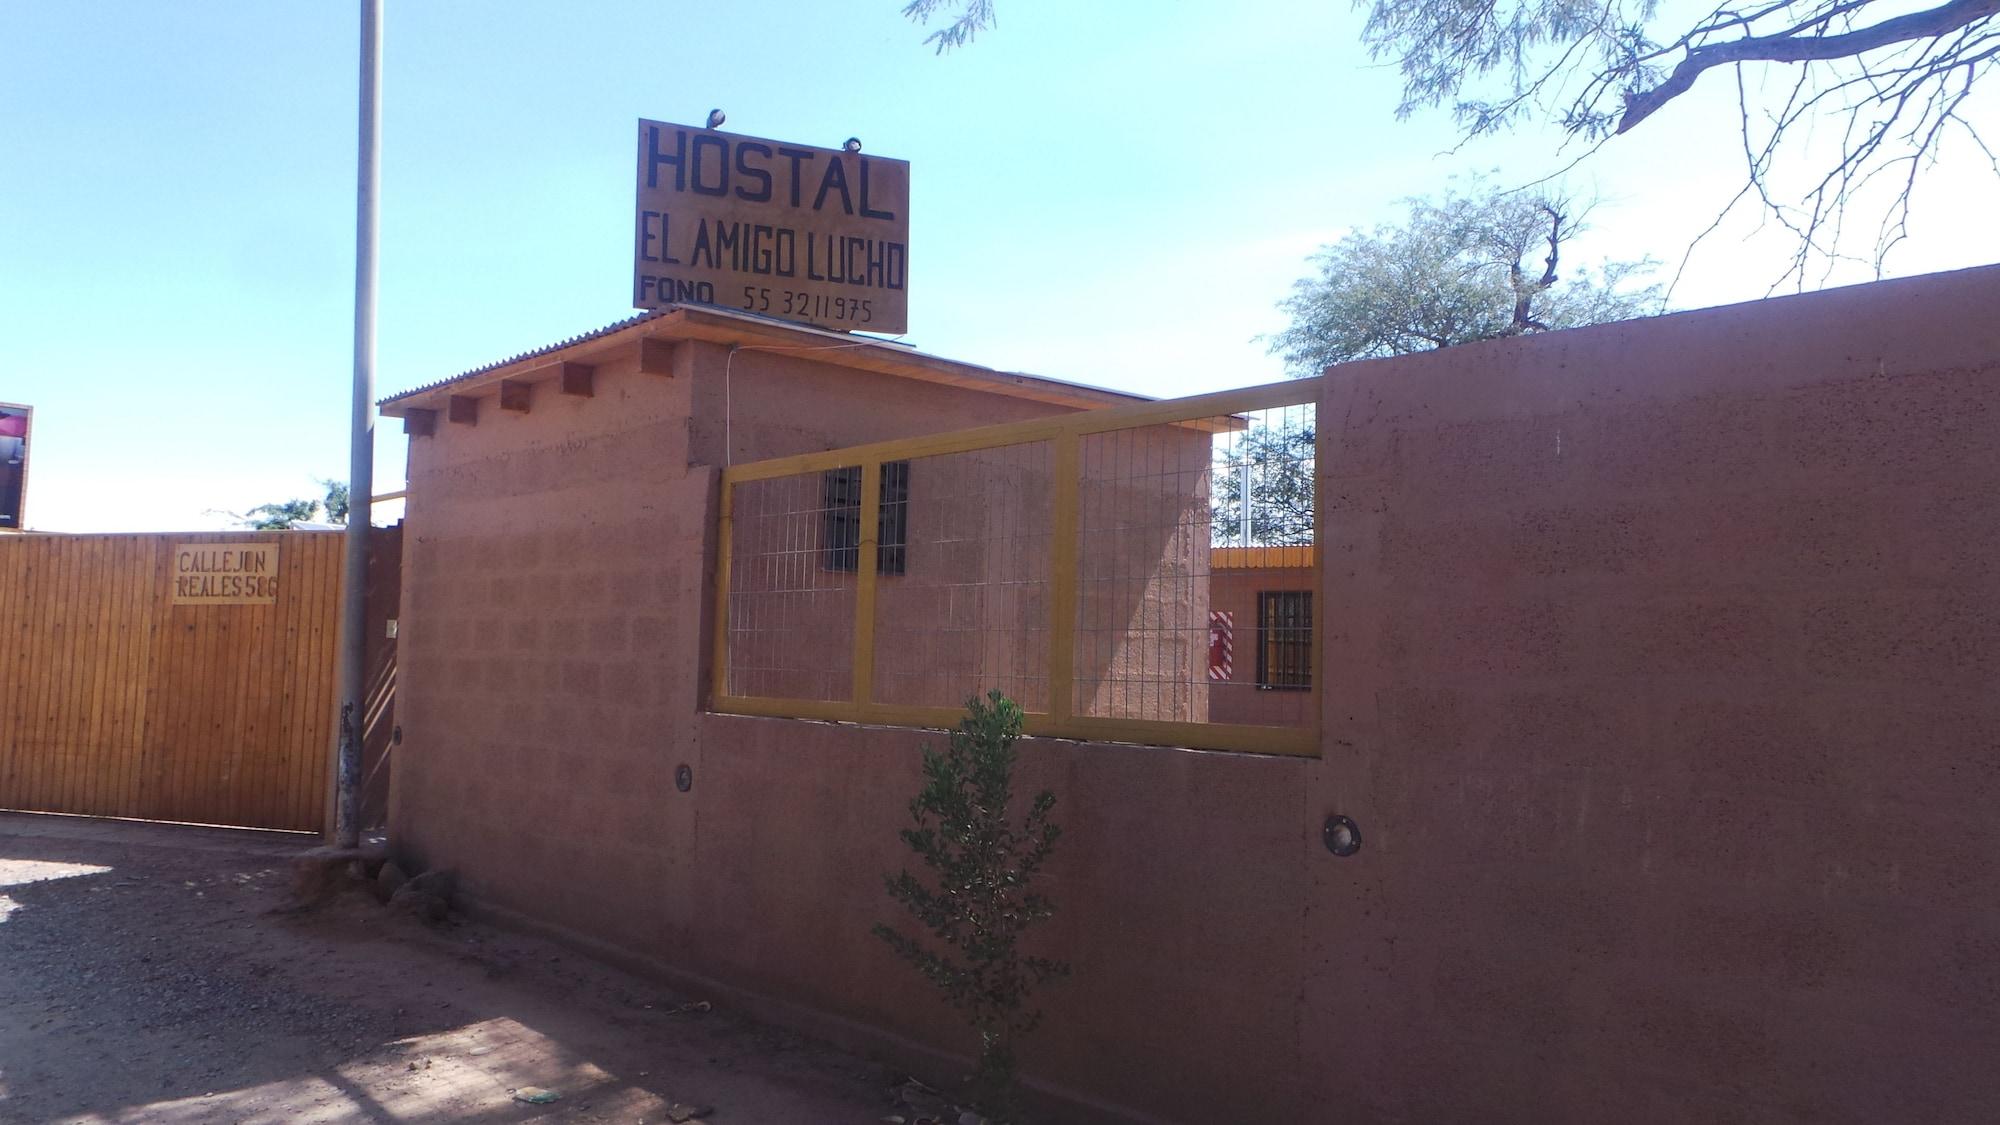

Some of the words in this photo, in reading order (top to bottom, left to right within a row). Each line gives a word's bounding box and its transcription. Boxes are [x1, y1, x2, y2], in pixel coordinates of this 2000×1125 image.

[647, 126, 895, 221] HOSTAL
[641, 211, 680, 264] EL
[691, 218, 795, 278] AMIGO
[807, 232, 905, 290] LUCHO
[640, 276, 714, 305] FONO
[743, 286, 770, 312] 55
[783, 291, 873, 323] 3211975
[179, 550, 266, 573] CALLEJON
[176, 575, 242, 598] REALES
